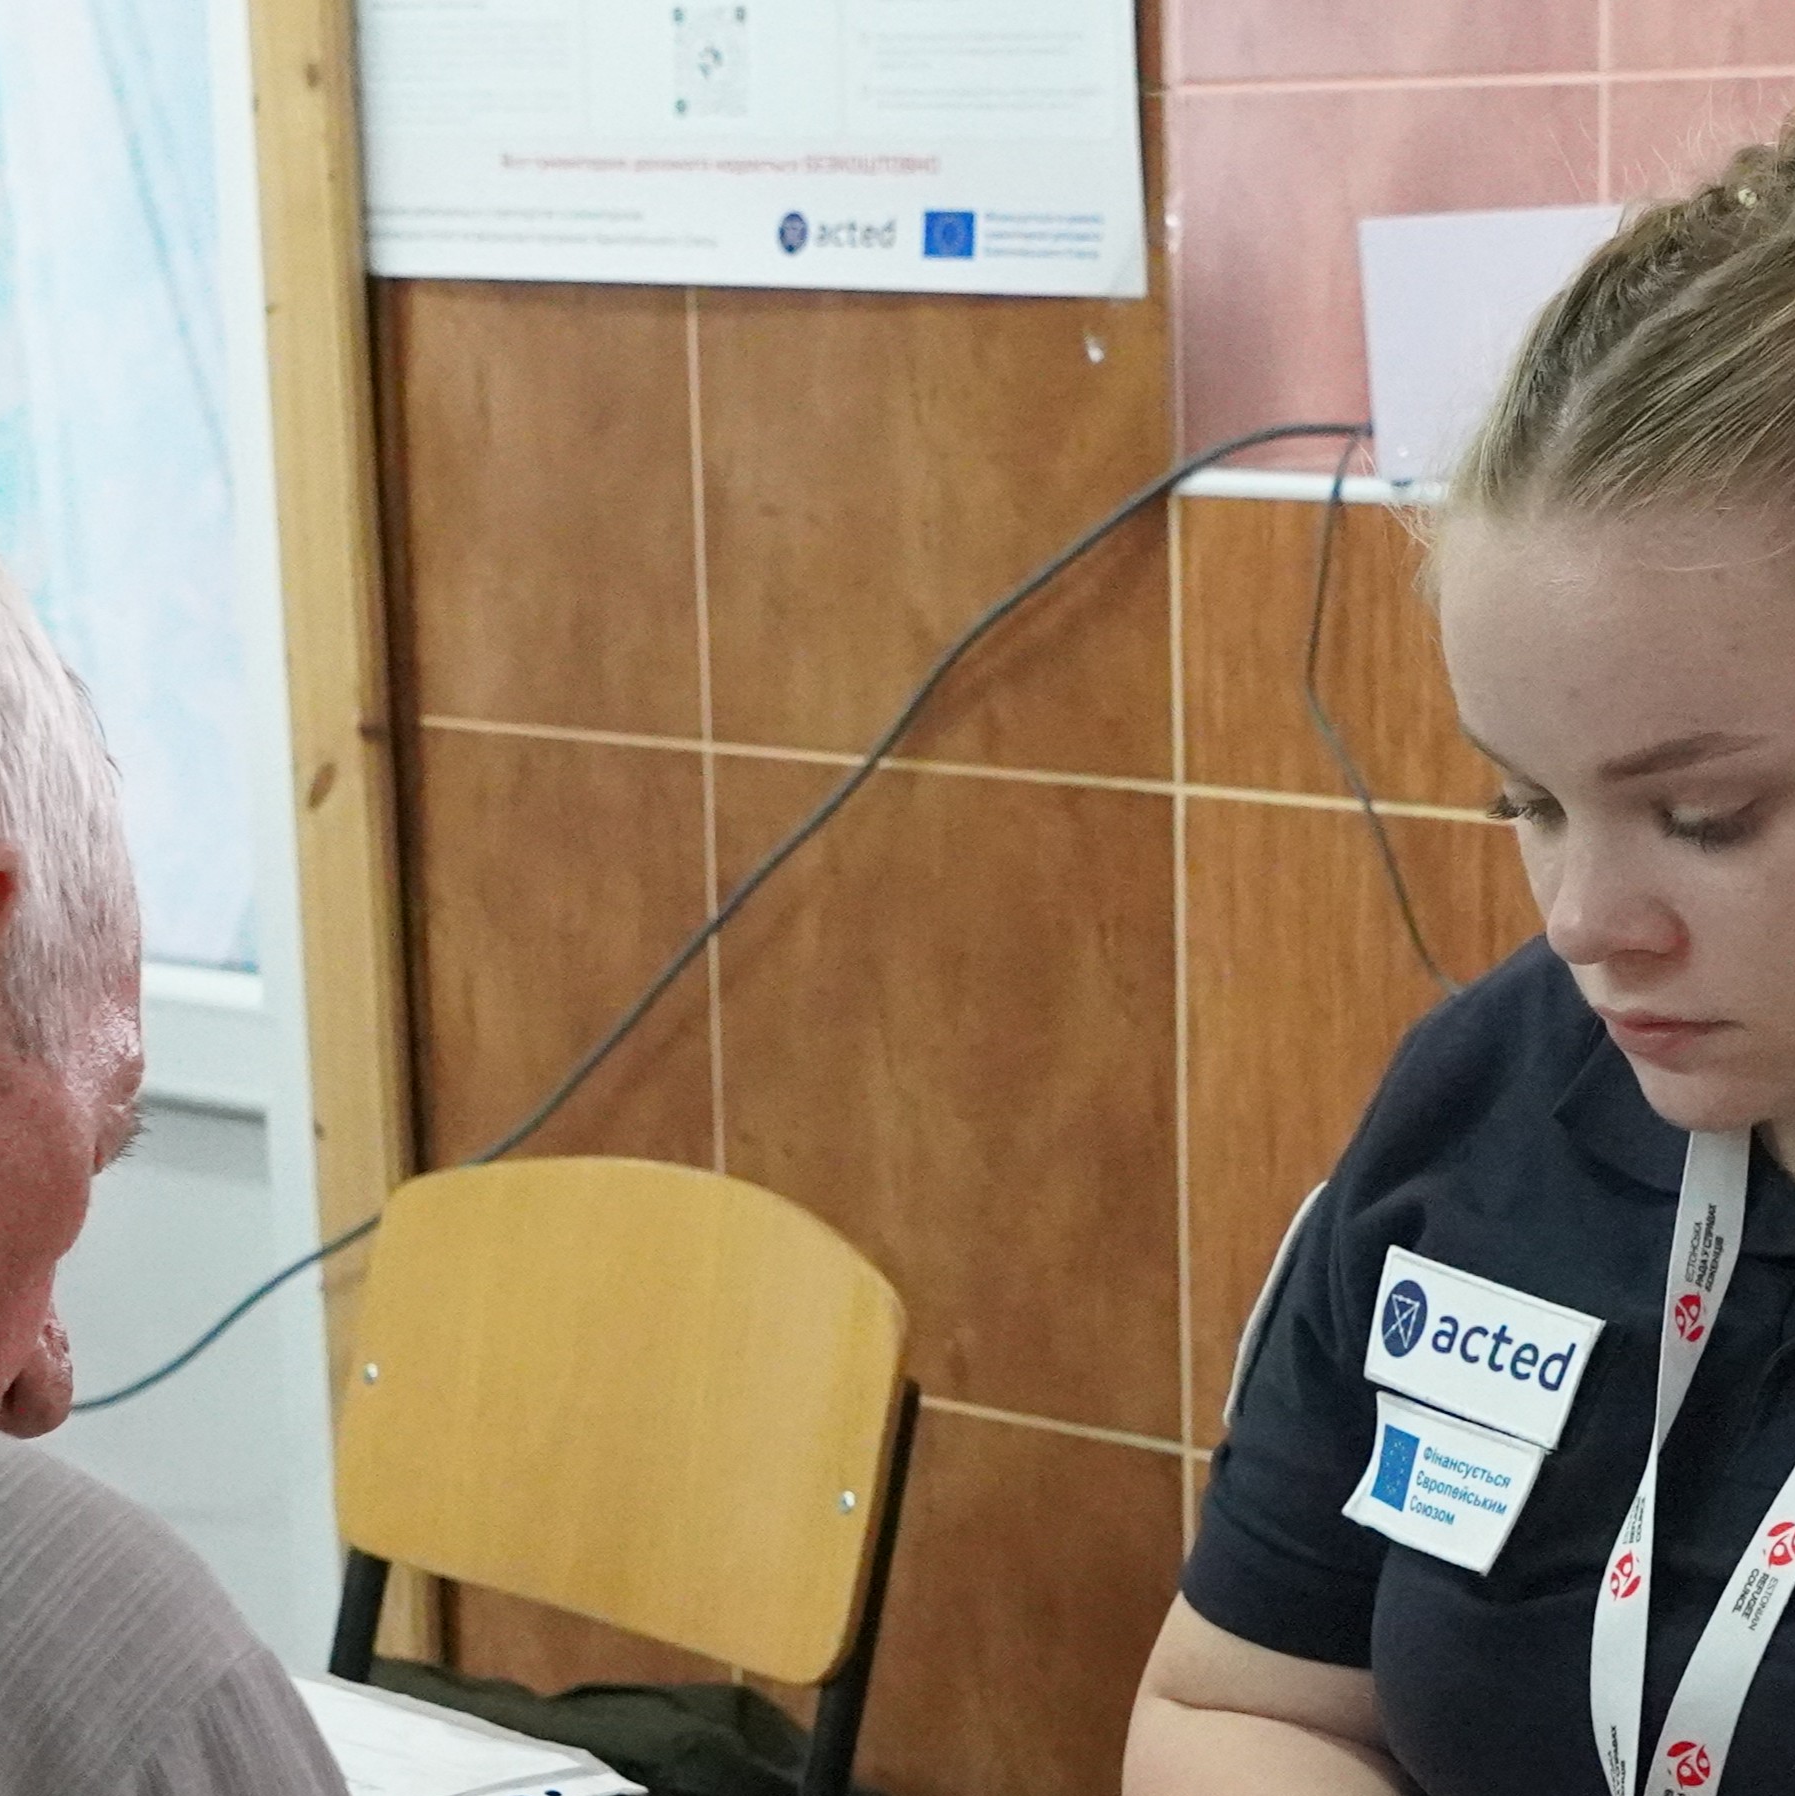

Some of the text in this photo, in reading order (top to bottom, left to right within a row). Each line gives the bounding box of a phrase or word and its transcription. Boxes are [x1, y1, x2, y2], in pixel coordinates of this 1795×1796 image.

[1430, 1314, 1577, 1392] acted
[1422, 1445, 1512, 1489] Фінансується
[1408, 1494, 1456, 1526] Союзом
[1415, 1470, 1508, 1516] Європейським
[1731, 1567, 1760, 1614] COUNCIL
[1741, 1572, 1770, 1620] REFUGEE
[1748, 1576, 1779, 1631] ESTONIAN
